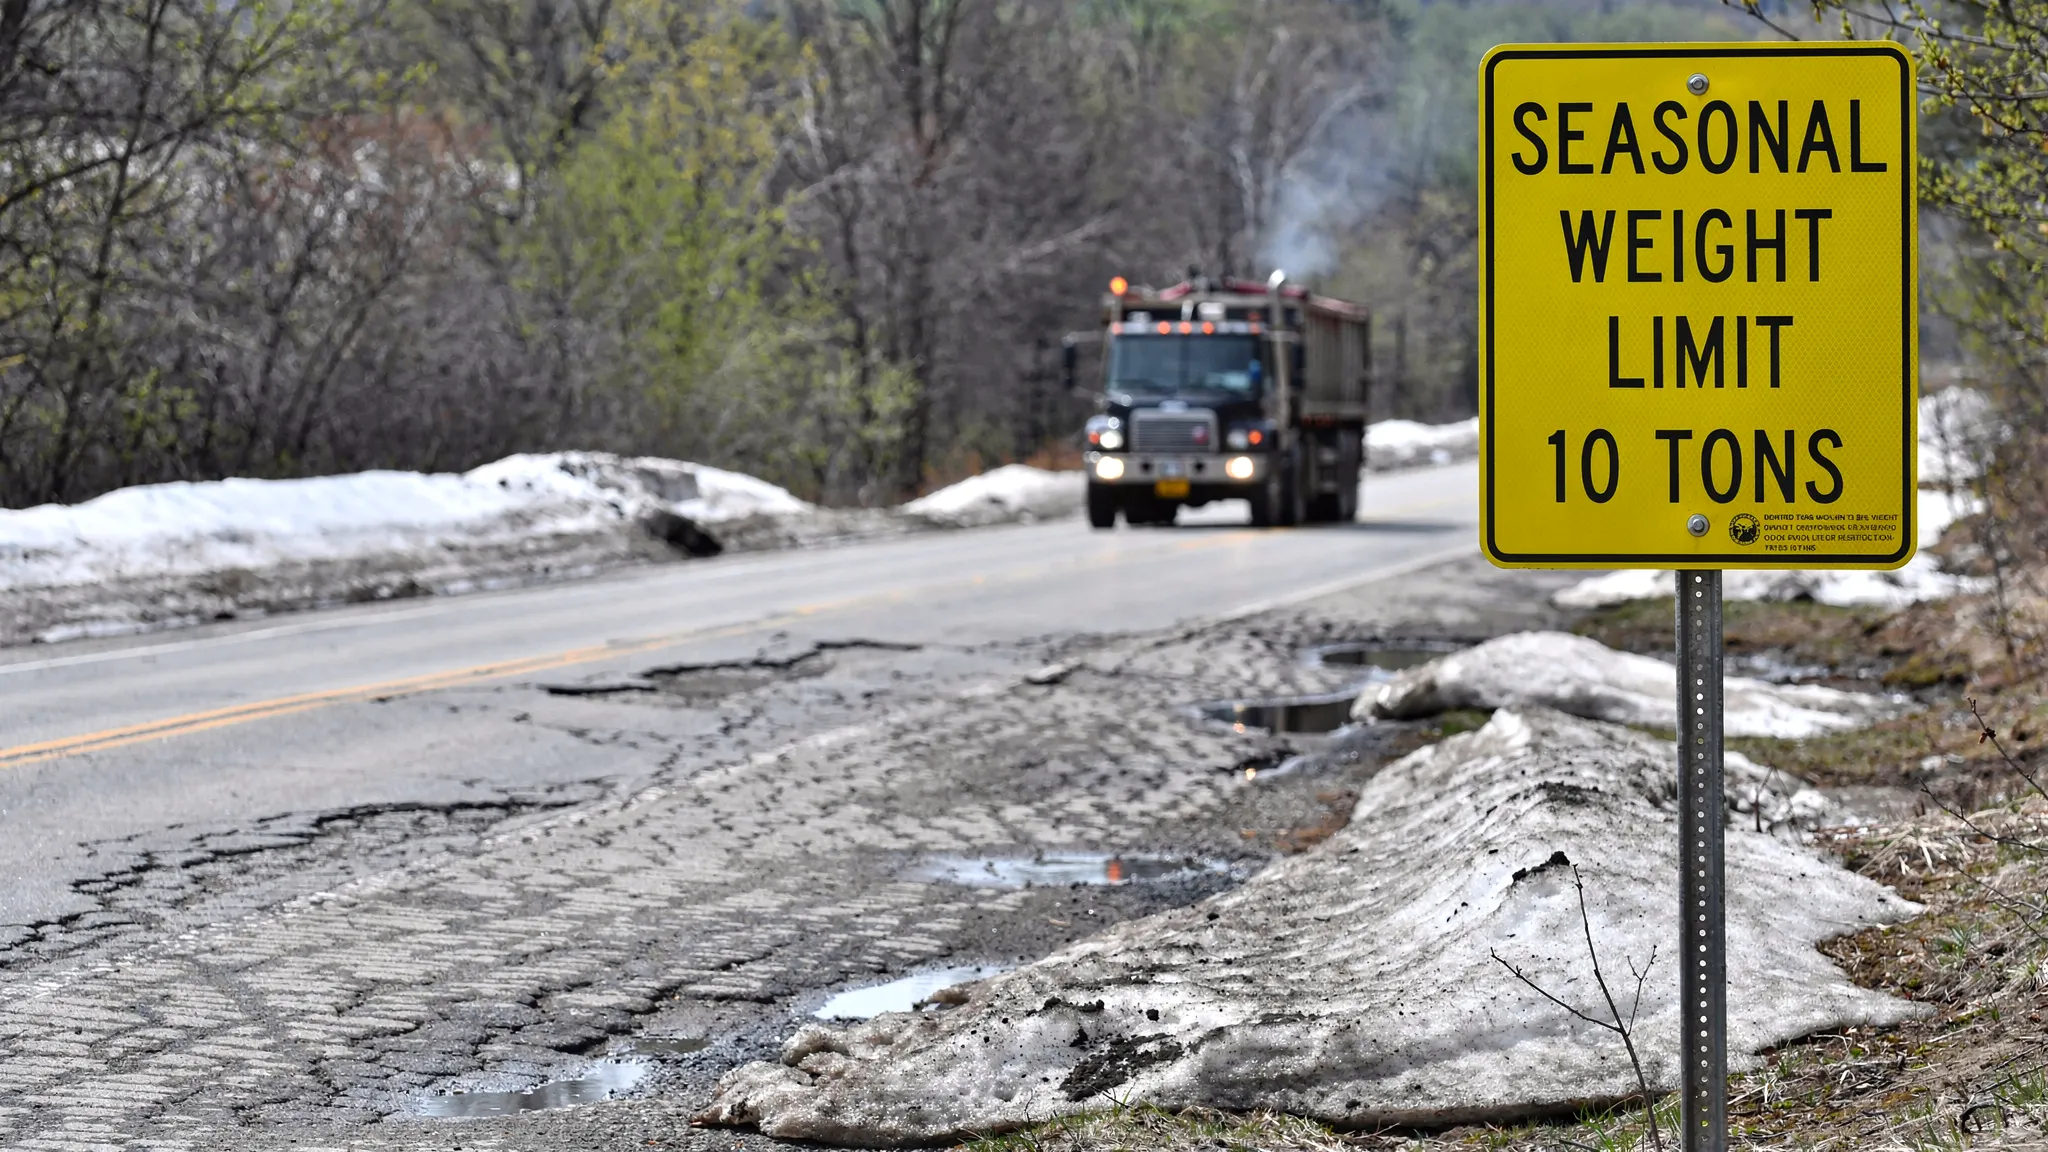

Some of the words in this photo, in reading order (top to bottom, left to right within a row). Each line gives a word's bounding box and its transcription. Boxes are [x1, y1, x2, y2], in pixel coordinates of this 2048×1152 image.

[1512, 100, 1887, 175] SEASONAL
[1560, 209, 1832, 283] WEIGHT
[1609, 316, 1793, 388] LIMIT
[1548, 429, 1619, 503] 10
[1655, 429, 1843, 504] TONS
